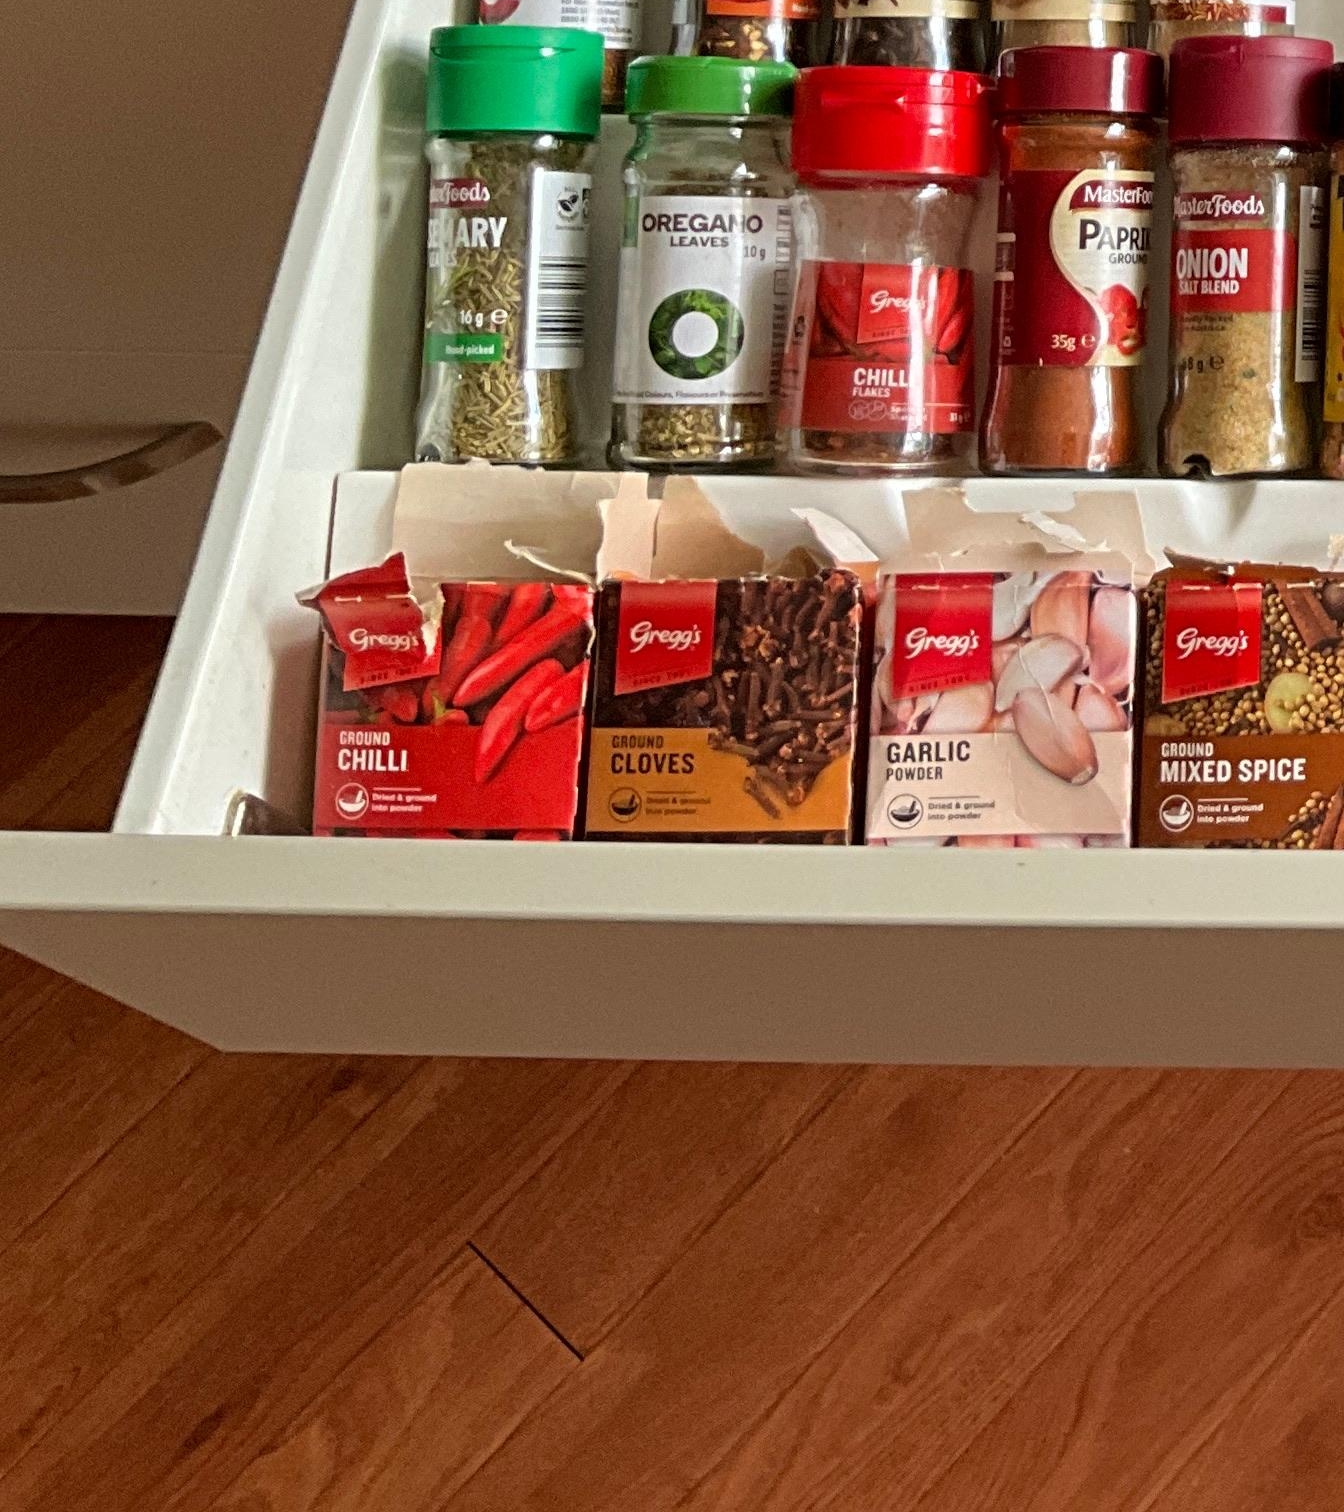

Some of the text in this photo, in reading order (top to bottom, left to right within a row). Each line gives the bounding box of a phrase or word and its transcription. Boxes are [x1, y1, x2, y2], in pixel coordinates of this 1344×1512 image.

[642, 213, 764, 233] OREGANO
[670, 236, 729, 248] LEAVES
[743, 245, 766, 261] 10 g
[1176, 247, 1249, 280] ONION
[1178, 279, 1240, 295] SALT BLEND
[459, 310, 484, 328] 16 g
[1051, 334, 1076, 351] 35g
[853, 367, 910, 388] CHILL
[852, 387, 891, 398] FLAKES
[349, 628, 419, 652] Gregg's
[629, 620, 702, 653] Gregg's
[905, 627, 980, 660] Gregg's
[1176, 627, 1249, 660] Gregg's
[340, 730, 391, 746] GROUND
[611, 734, 664, 749] GROUND
[887, 740, 971, 764] GARLIC
[1161, 742, 1214, 758] GROUND
[338, 748, 408, 772] CHILLI
[610, 752, 695, 775] CLOVES
[886, 766, 943, 781] POWDER
[1160, 758, 1307, 783] MIXED SPICE
[928, 802, 952, 810] Dried
[963, 801, 995, 810] ground
[1197, 804, 1221, 813] Dried
[1231, 803, 1264, 813] ground
[928, 812, 981, 821] into powder
[1216, 814, 1250, 824] powder
